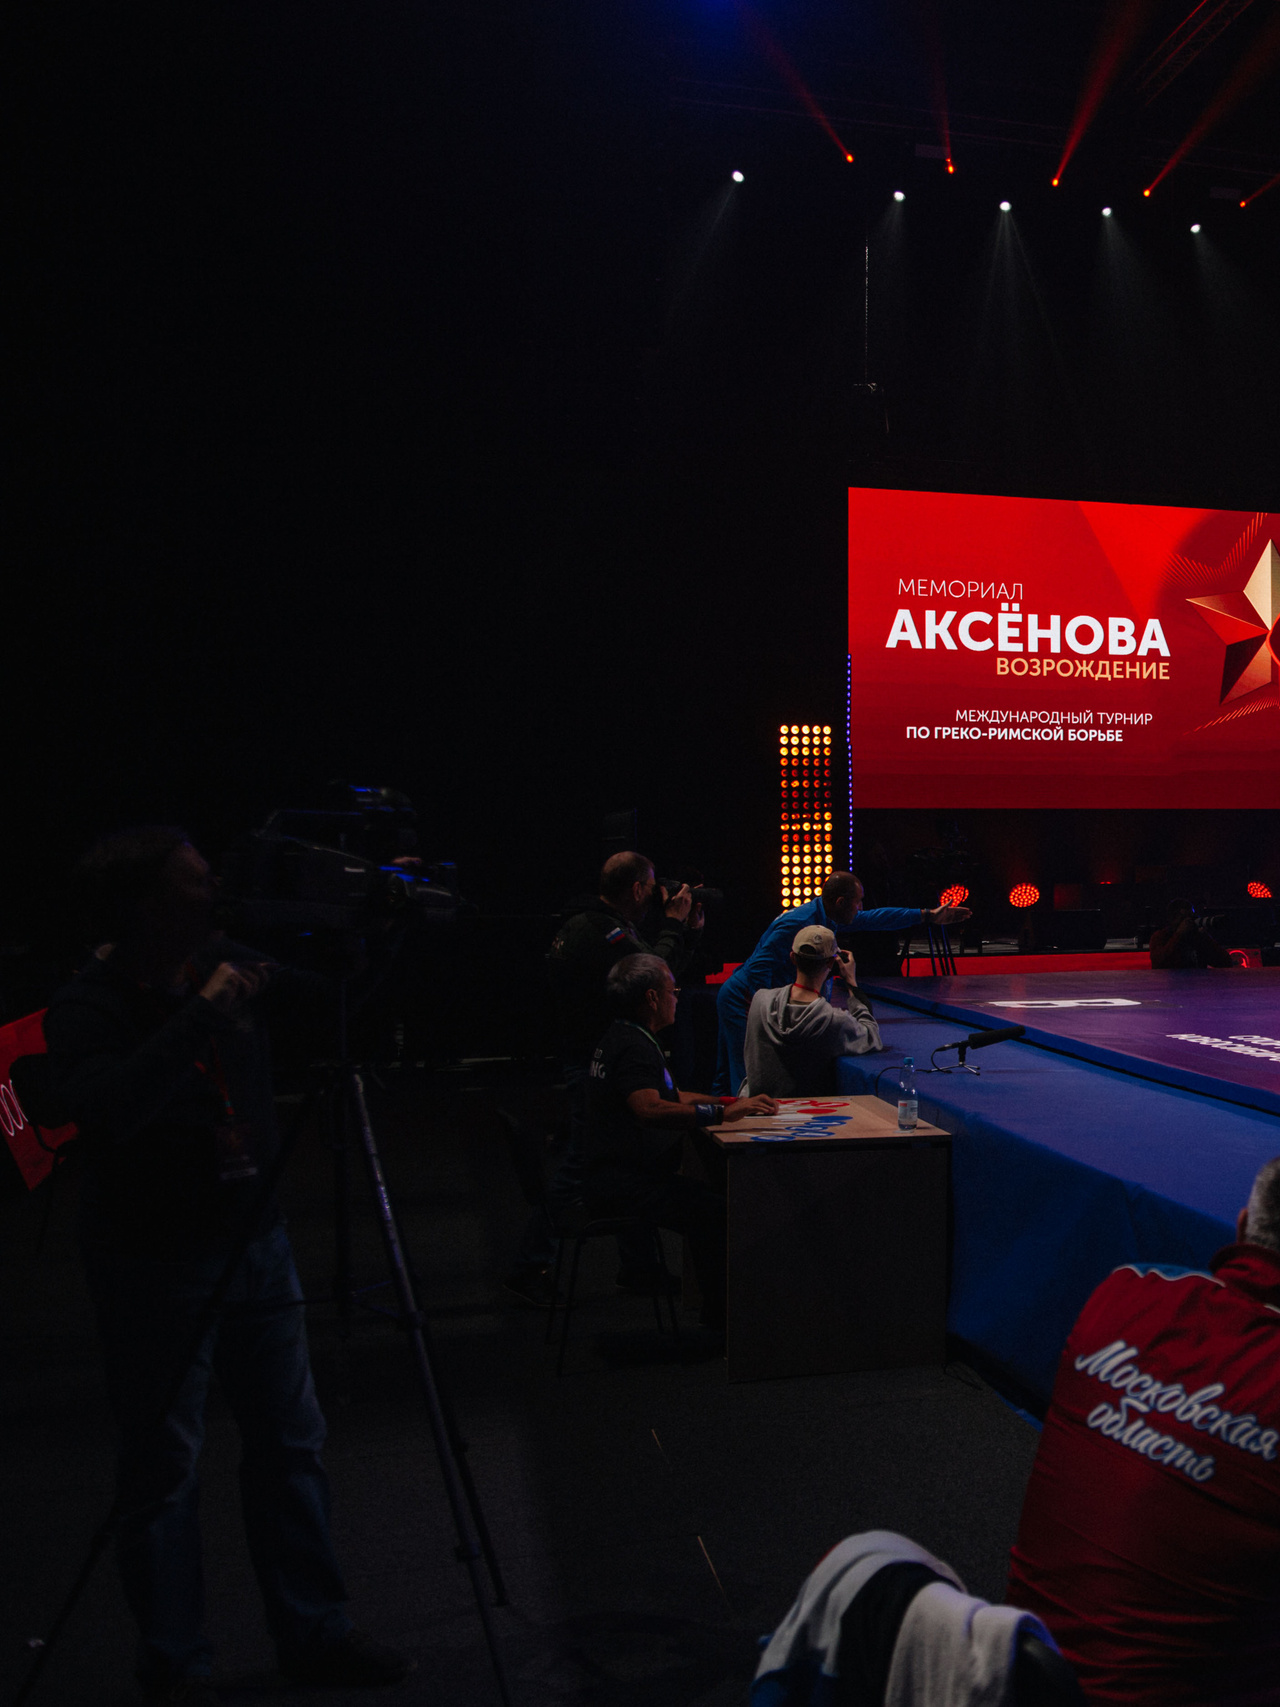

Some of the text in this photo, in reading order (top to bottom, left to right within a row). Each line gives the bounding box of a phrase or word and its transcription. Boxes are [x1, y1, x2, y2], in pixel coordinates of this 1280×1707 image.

[898, 578, 1023, 600] МЕМОРИАЛ
[886, 602, 1171, 657] АКСЁНОВА
[996, 657, 1171, 681] ВОЗРОЖДЕНИЕ
[955, 709, 1153, 727] МЕЖДУНАРОДНЫЙ ТУРНИР
[906, 724, 1124, 742] ПО ГРЕКО-РИМСКОЙ БОРЬБЕ
[1074, 1339, 1280, 1461] Московская
[1087, 1395, 1216, 1482] область
